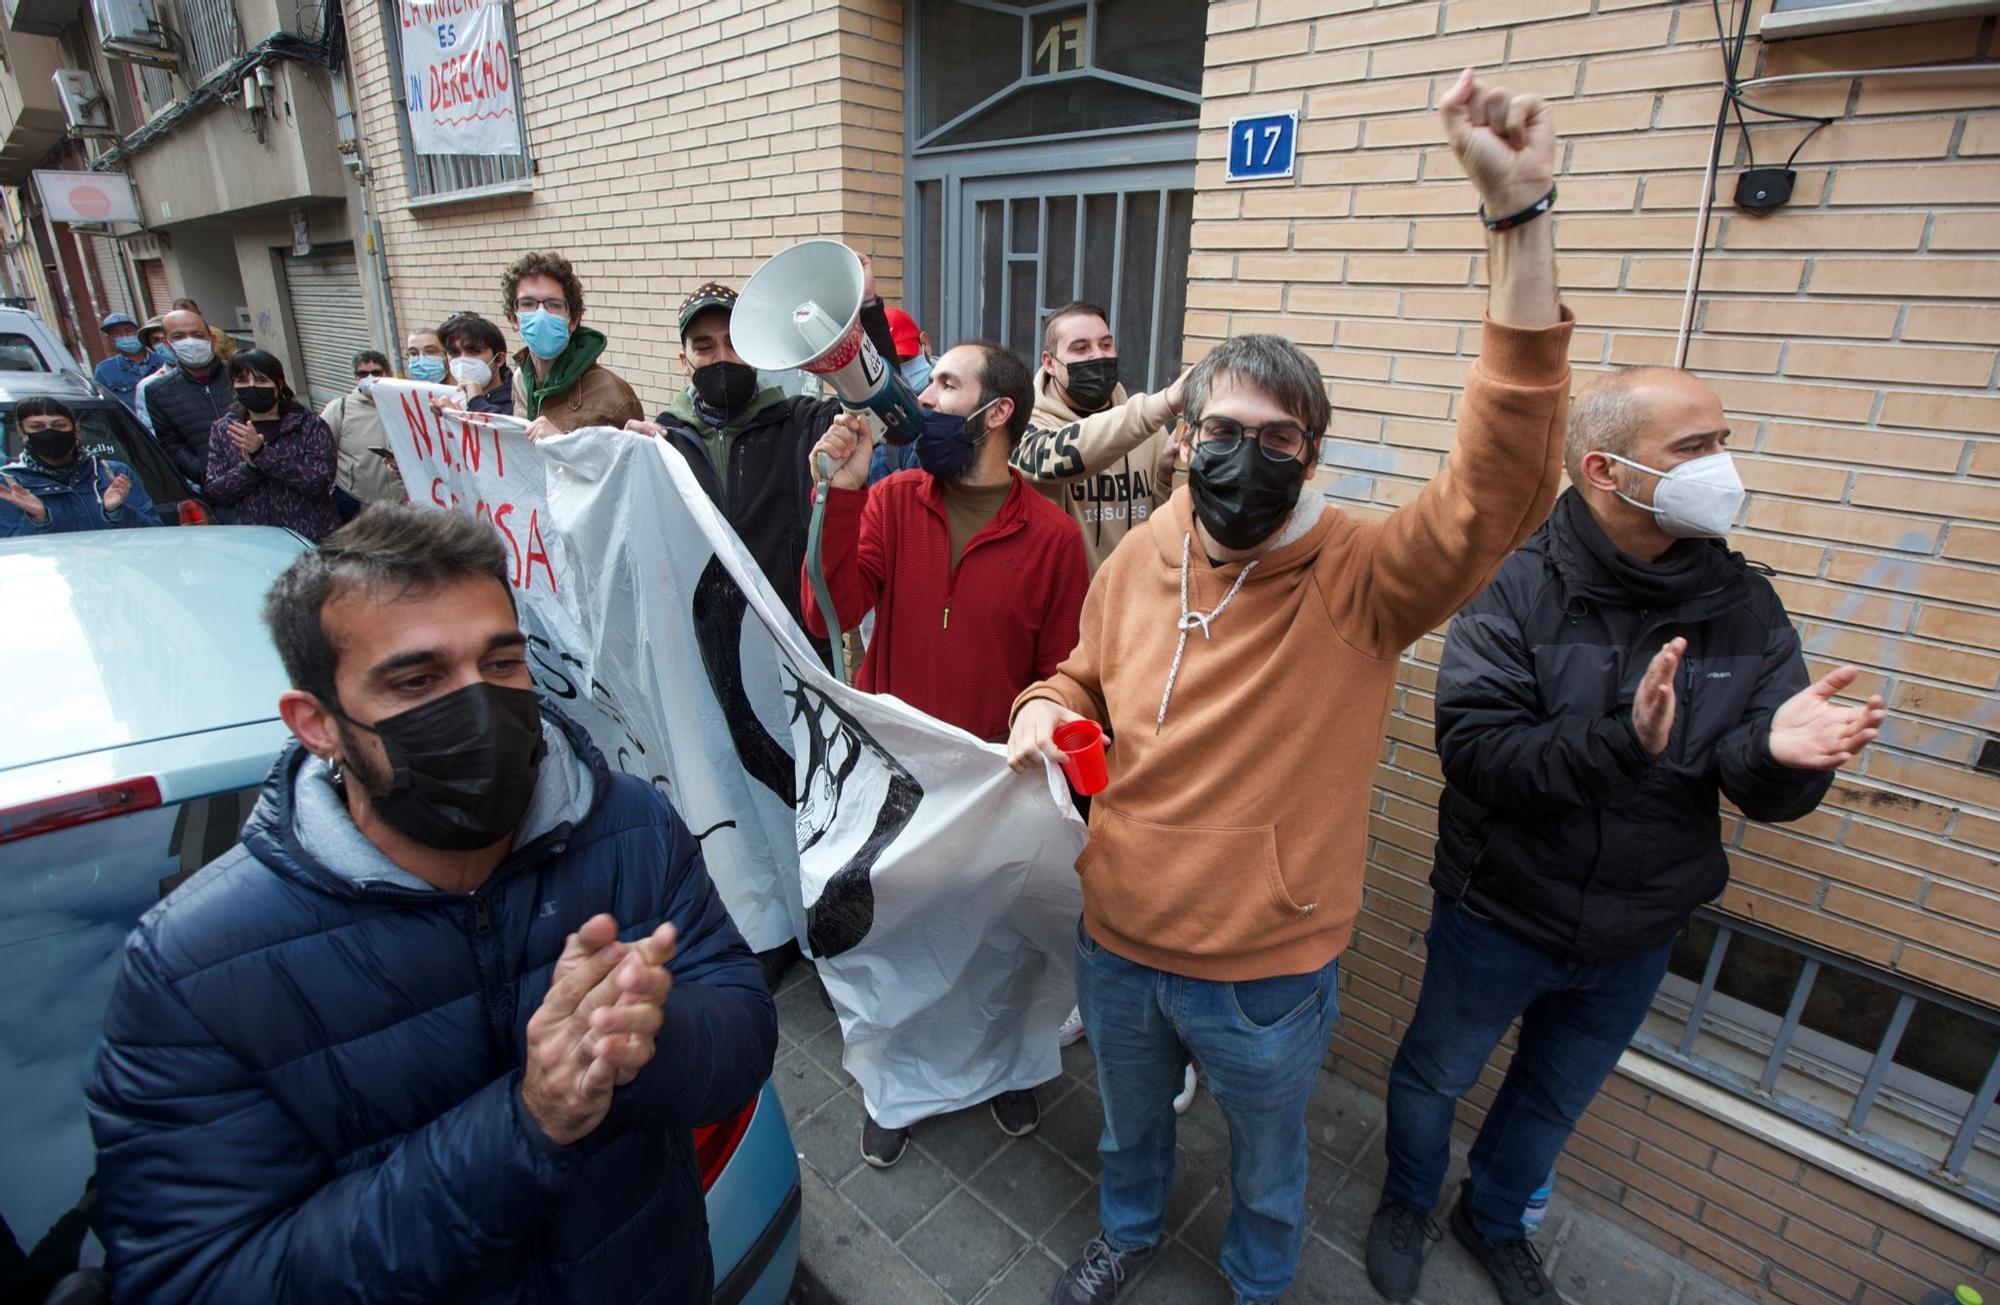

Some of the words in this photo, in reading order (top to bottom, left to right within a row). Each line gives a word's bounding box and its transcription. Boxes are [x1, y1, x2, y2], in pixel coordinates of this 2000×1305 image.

[437, 24, 456, 48] ES
[1036, 16, 1086, 75] 17
[406, 72, 423, 112] UN
[429, 40, 509, 112] DERECHO
[1243, 125, 1283, 167] 17
[1084, 505, 1148, 523] ISSUES
